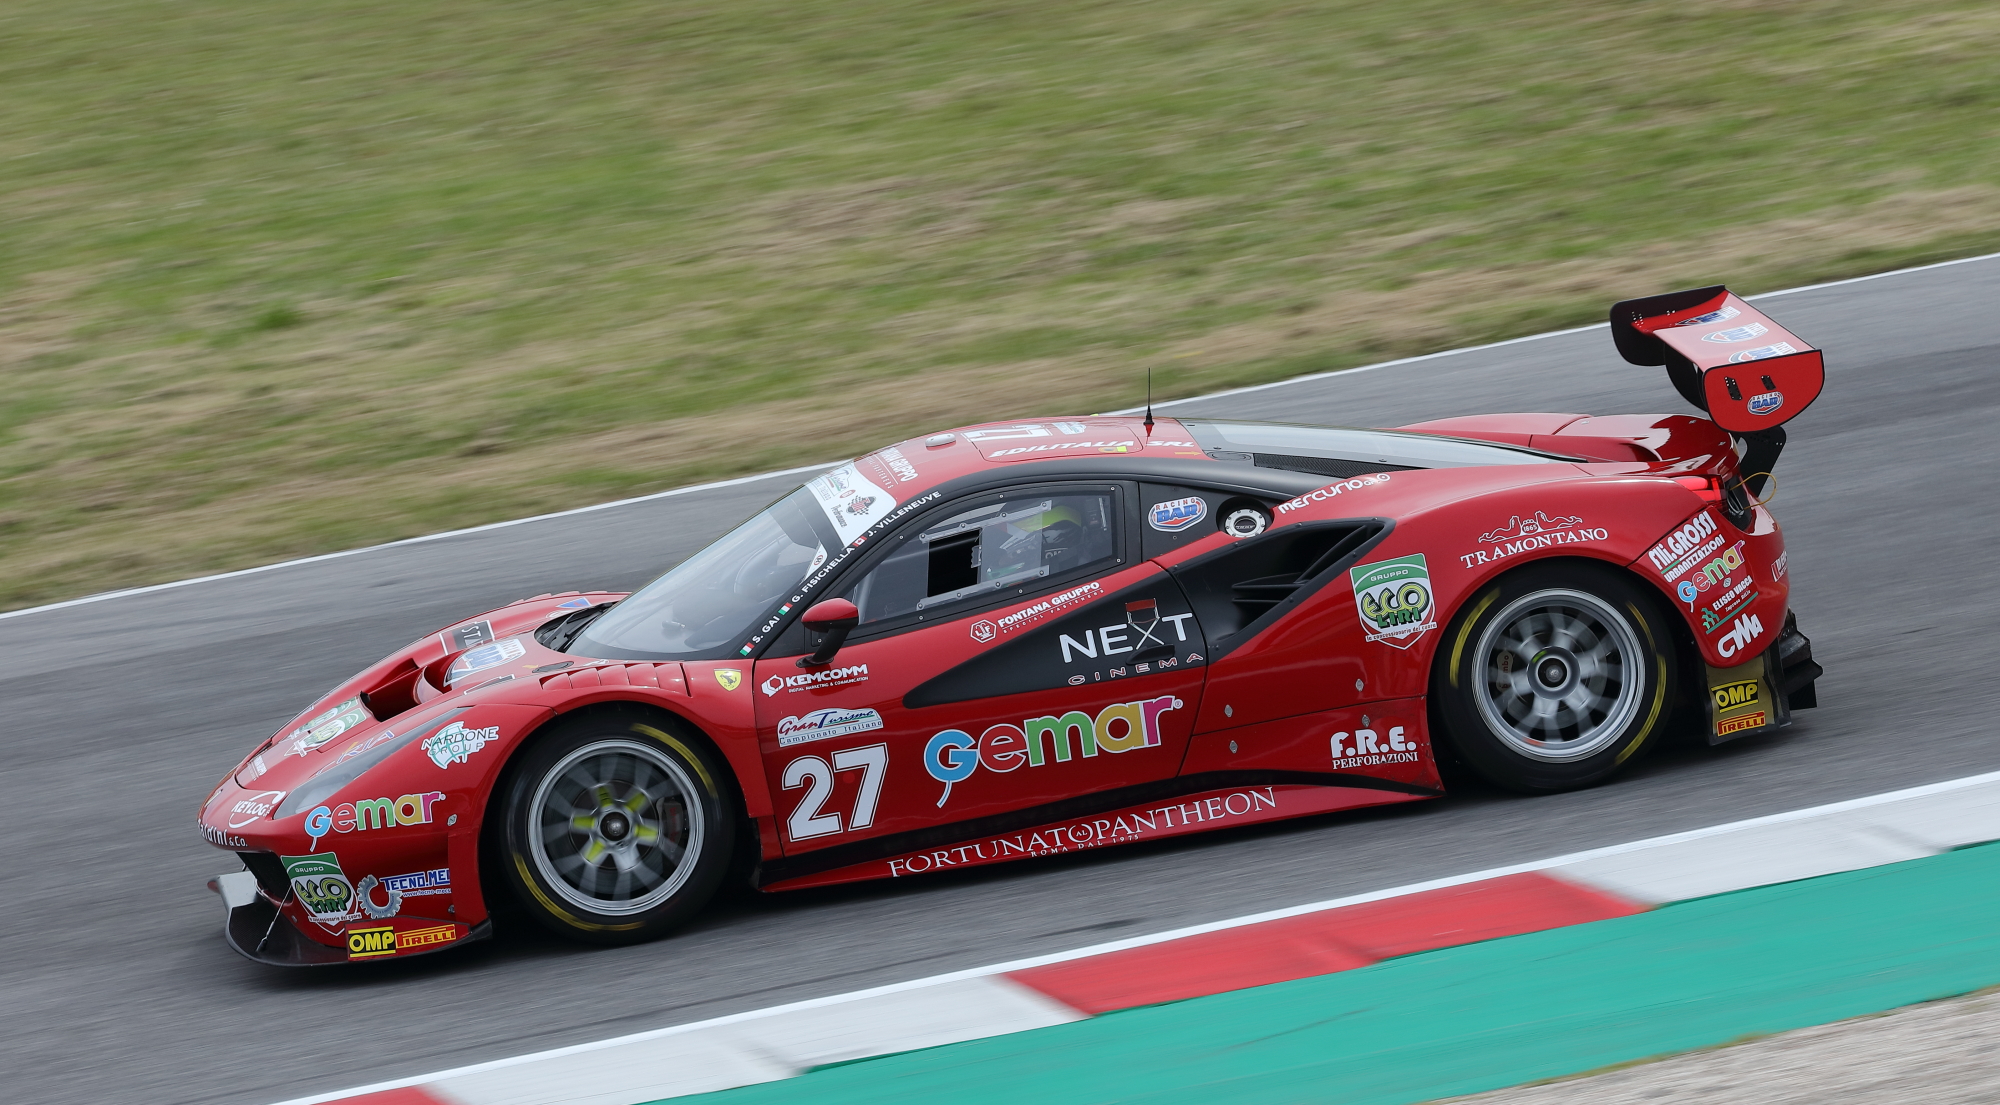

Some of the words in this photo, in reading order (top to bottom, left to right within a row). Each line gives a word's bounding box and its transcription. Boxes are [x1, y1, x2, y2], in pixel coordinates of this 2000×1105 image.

[1752, 397, 1778, 409] BAR
[989, 440, 1134, 458] EDILITALIA
[1146, 440, 1195, 448] SRL
[1156, 498, 1196, 510] RACING
[1278, 479, 1363, 514] mercurio
[875, 490, 942, 529] VILLENEUVE
[1155, 504, 1198, 523] BAR
[1460, 528, 1608, 568] TRAMONTANO
[1664, 534, 1726, 582] URBANIZZAZIONI
[792, 594, 804, 603] G.
[802, 547, 855, 593] FISICHELLA
[1370, 570, 1408, 582] GRUPPO
[1677, 540, 1745, 612] Gemar
[998, 601, 1051, 628] FONTANA
[1051, 582, 1100, 606] GRUPPO
[1361, 582, 1430, 621] ECO
[1712, 590, 1736, 611] ELISEO
[1733, 575, 1753, 594] VACCA
[752, 636, 764, 644] S.
[762, 616, 780, 633] GAI
[1003, 614, 1044, 634] SPECIAL
[1376, 608, 1422, 628] LIRI
[1060, 611, 1193, 663] NEXT
[1718, 613, 1764, 658] CMA
[786, 664, 868, 687] KEMCOMM
[1068, 652, 1203, 686] CINEMA
[1716, 684, 1758, 707] OMP
[780, 730, 837, 744] Campionato
[844, 720, 882, 732] Italiano
[1717, 711, 1765, 735] PIRELLI
[423, 728, 498, 748] NARDONE
[429, 742, 483, 756] GROUP
[924, 696, 1176, 808] Gemar
[1332, 752, 1418, 770] PERFORAZIONI
[782, 742, 889, 842] 27
[230, 800, 270, 816] KEYLOG
[304, 791, 441, 852] Gemar
[1030, 846, 1069, 858] ROMA
[1078, 840, 1103, 850] DAL
[1112, 834, 1139, 844] 1975
[380, 868, 450, 891] TECNO.ME
[350, 931, 395, 952] OMP
[396, 925, 456, 948] PIRELLI
